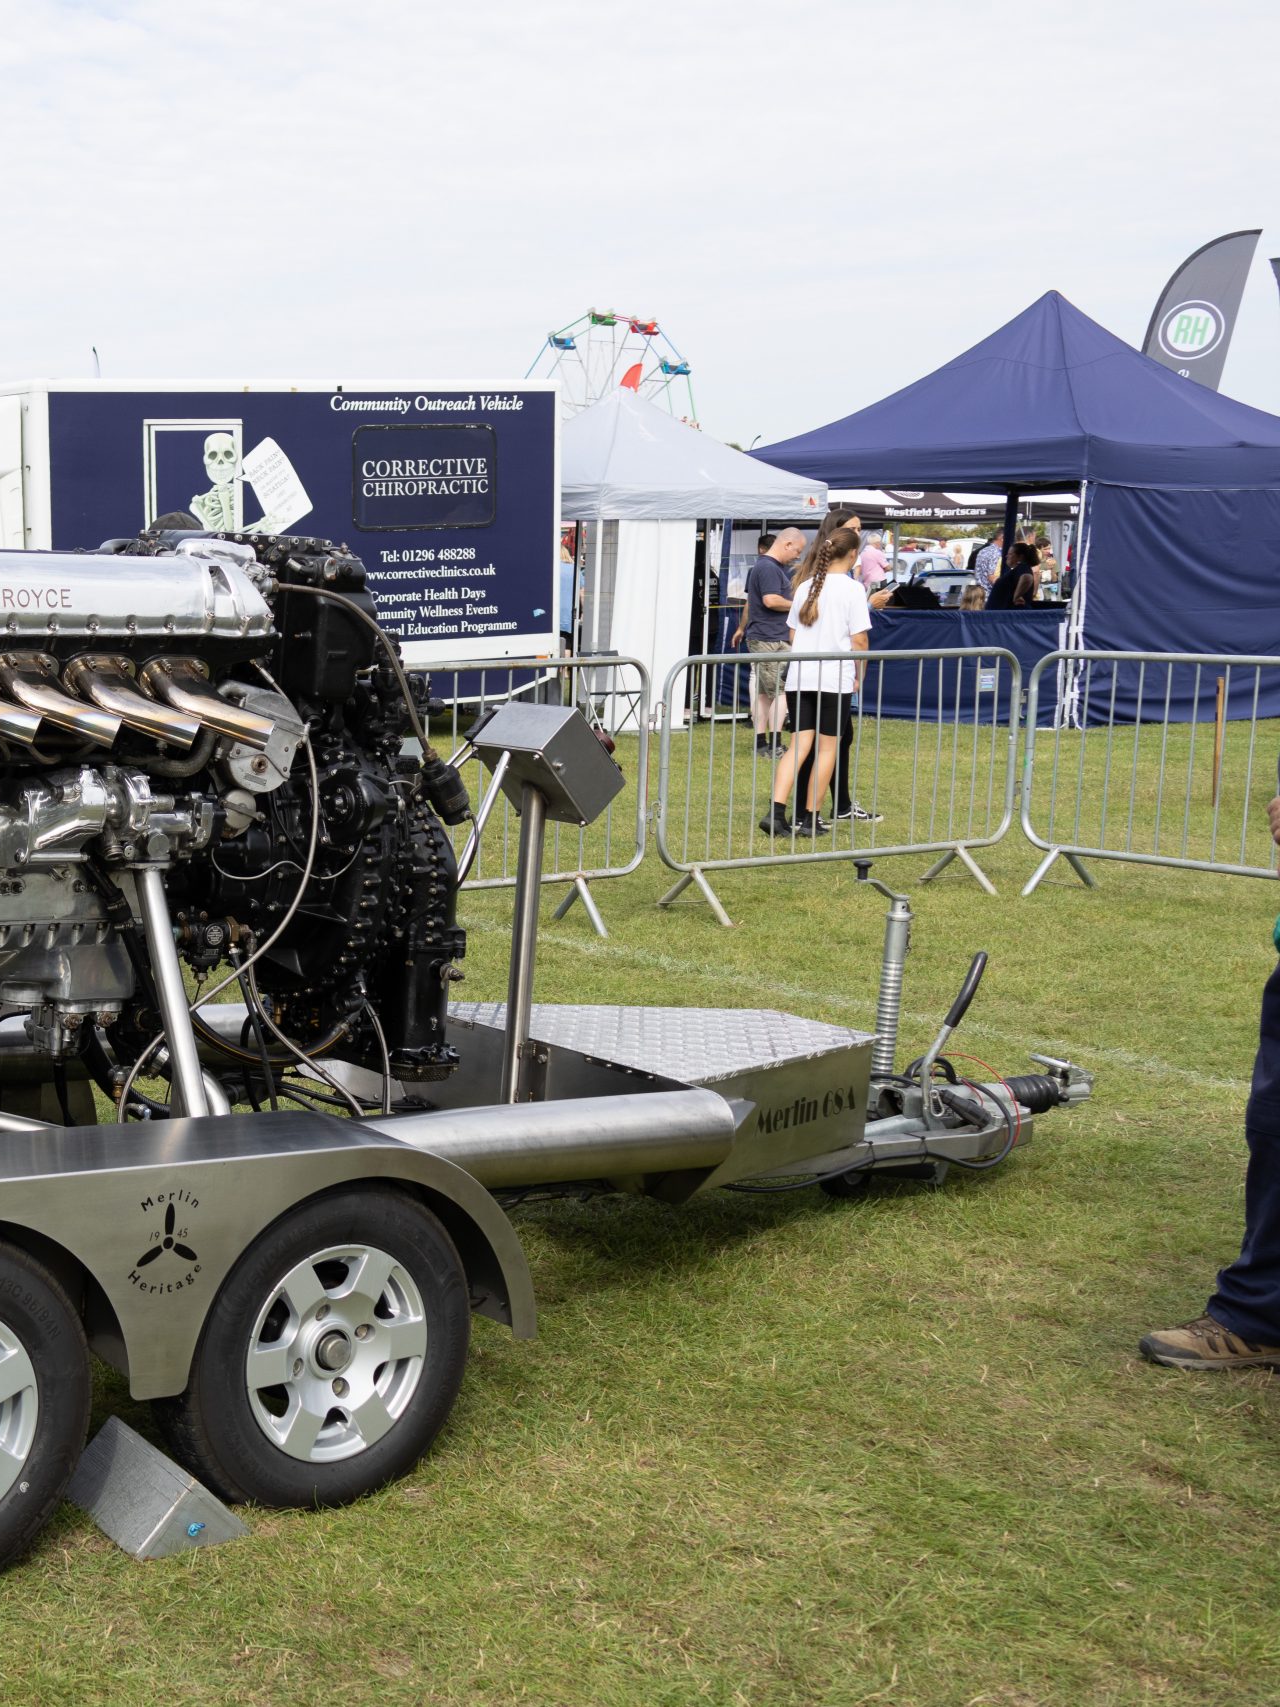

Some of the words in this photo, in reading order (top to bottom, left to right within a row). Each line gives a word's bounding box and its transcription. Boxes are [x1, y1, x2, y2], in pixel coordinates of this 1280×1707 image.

[1173, 314, 1210, 345] RH
[330, 396, 411, 414] Community
[415, 395, 476, 411] Outreach
[479, 395, 524, 411] Vehicle
[362, 458, 488, 477] CORRECTIVE
[363, 479, 489, 497] CHIROPRACTIC
[885, 508, 932, 516] Westfield
[934, 508, 986, 518] Sportscars
[380, 550, 400, 563] Tel:
[402, 549, 435, 562] 01296
[437, 548, 476, 560] 488288
[365, 564, 496, 581] ww.correctiveclinics.co.uk
[371, 591, 422, 605] Corporate
[424, 588, 458, 601] Health
[461, 587, 486, 601] Days
[376, 607, 417, 621] munity
[419, 605, 463, 618] Wellness
[466, 604, 498, 616] Events
[407, 622, 458, 635] Education
[461, 620, 517, 633] Programme
[754, 1097, 818, 1137] Merlin
[141, 1190, 199, 1212] Merlin
[128, 1264, 202, 1294] Heritage
